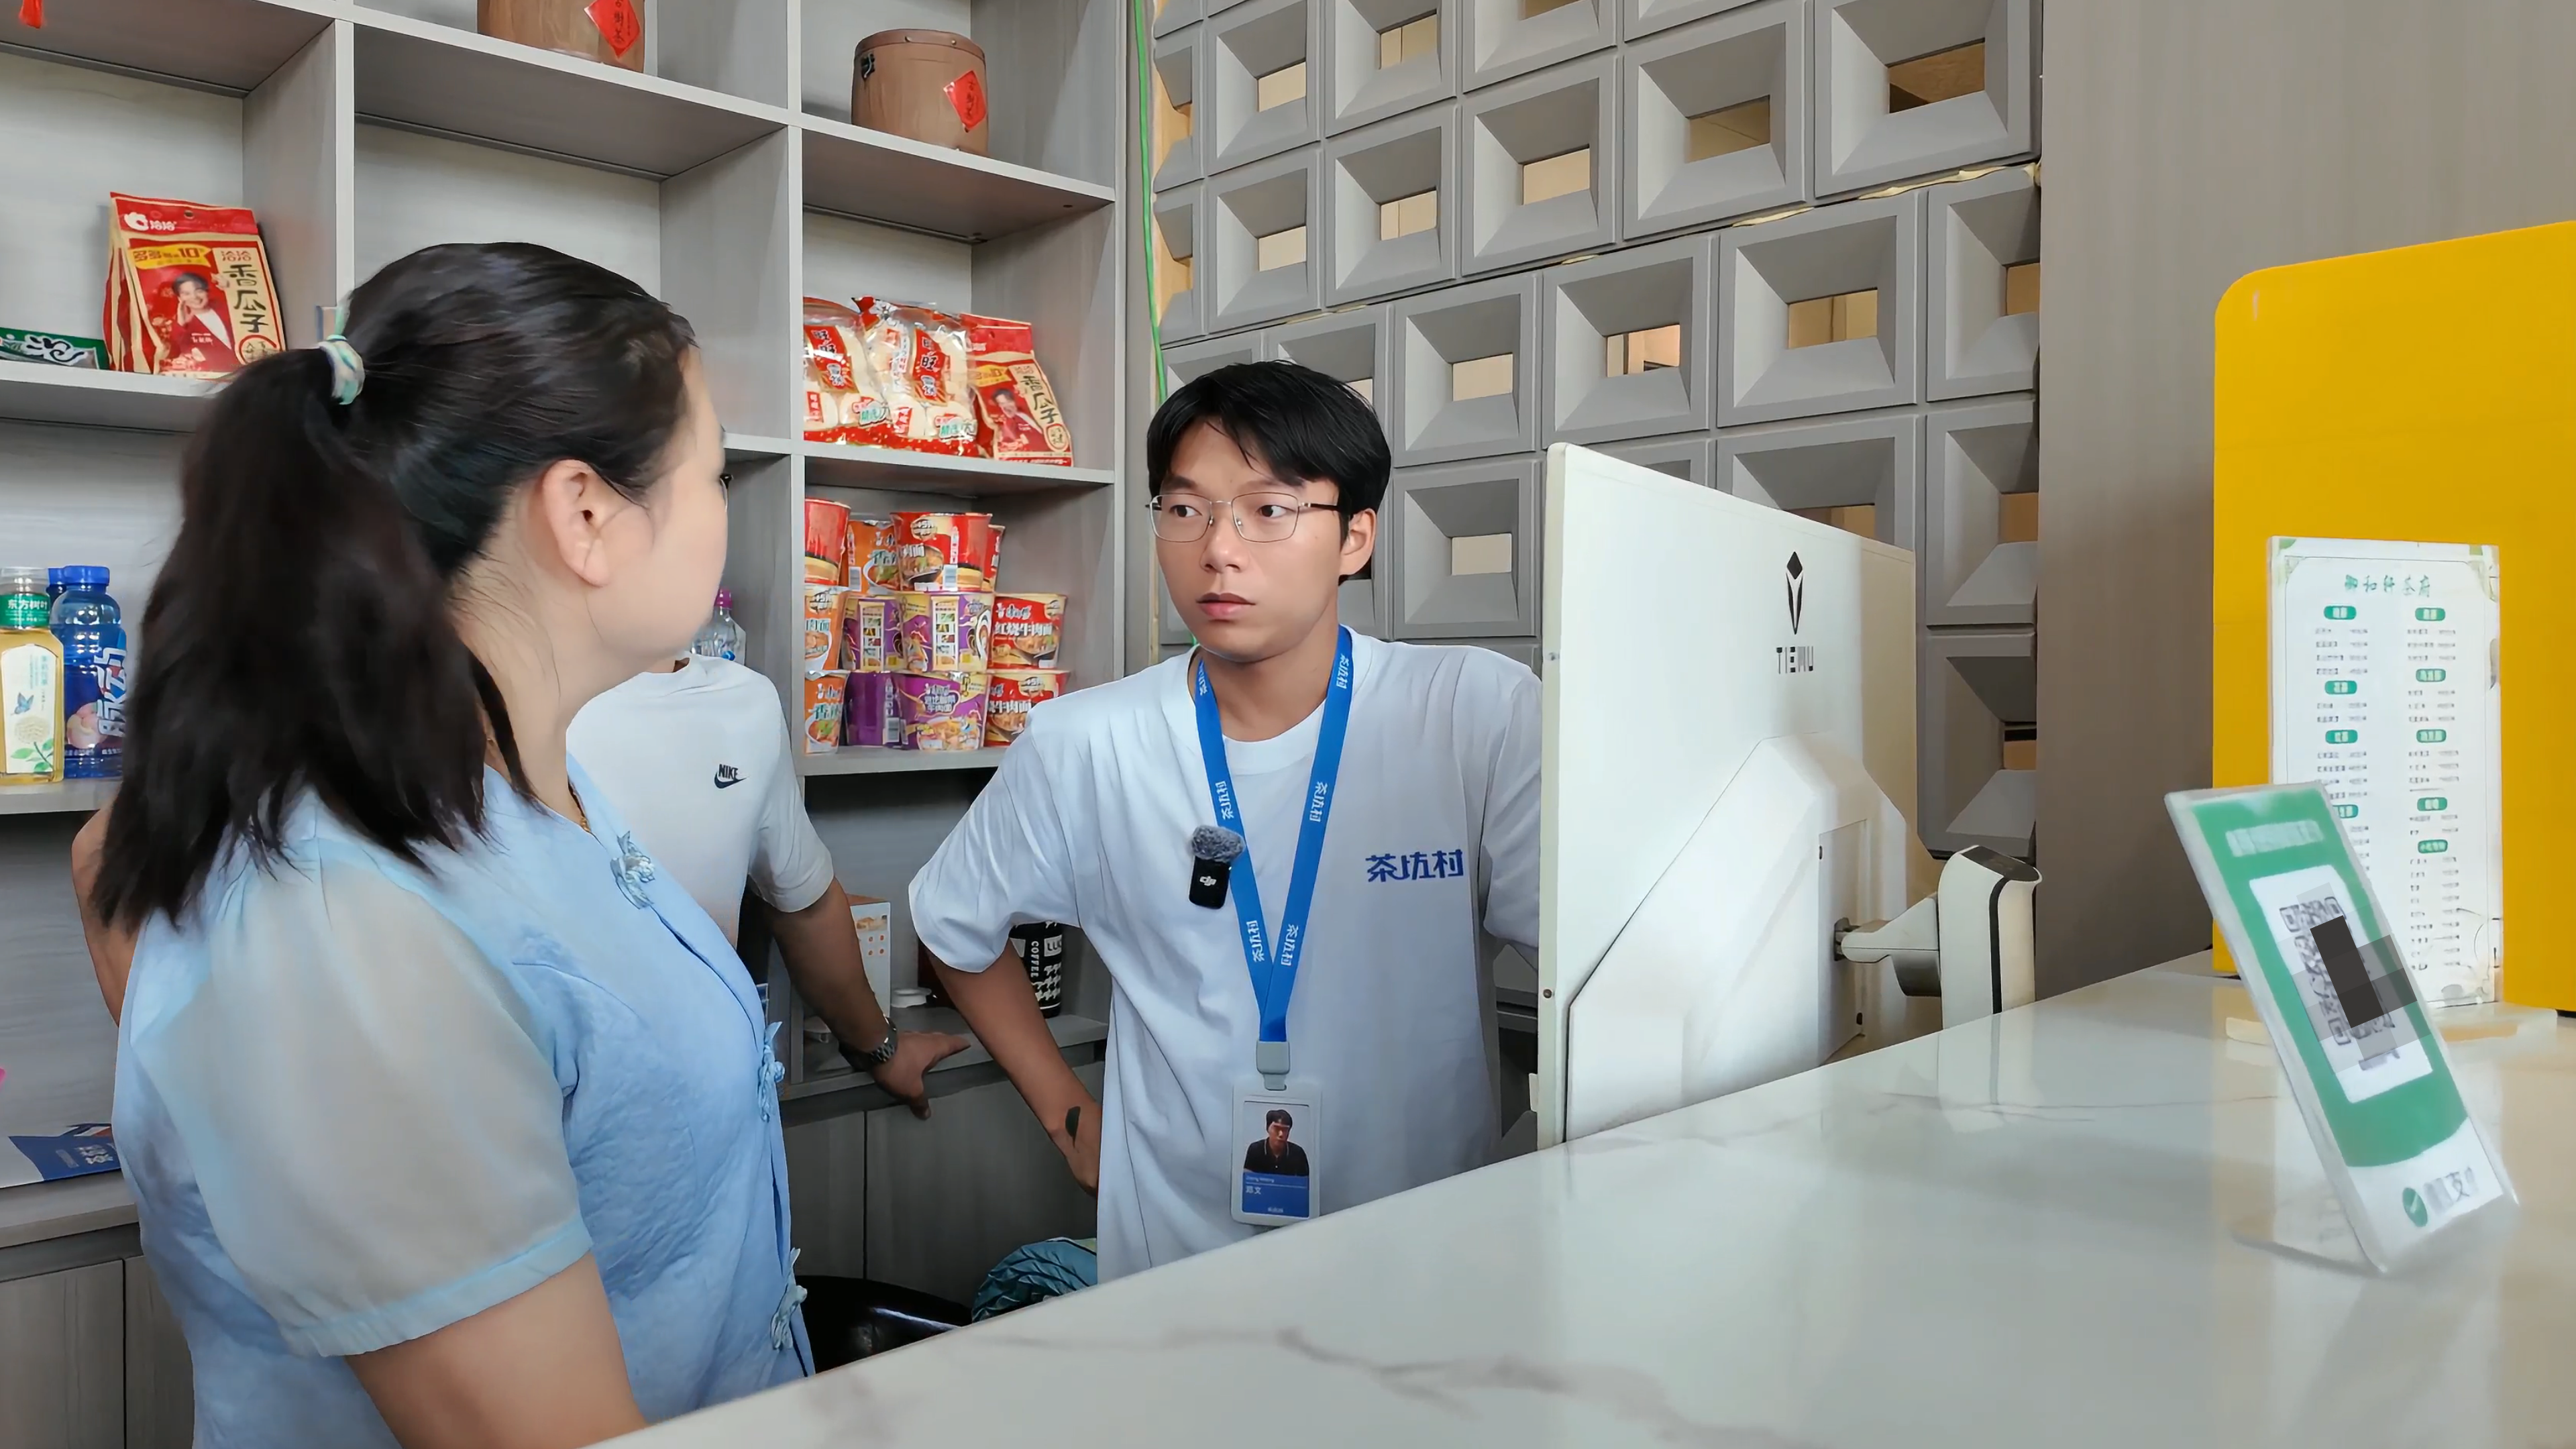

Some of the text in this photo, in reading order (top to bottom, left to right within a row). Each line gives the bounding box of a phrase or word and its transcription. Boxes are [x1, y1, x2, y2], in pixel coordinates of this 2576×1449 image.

[223, 264, 269, 333] 香瓜子
[1020, 375, 1059, 423] 香瓜子
[8, 599, 48, 610] 东方树叶
[718, 763, 739, 780] NIKE
[1365, 849, 1464, 882] 茶坊村
[1030, 941, 1039, 977] COFFEE
